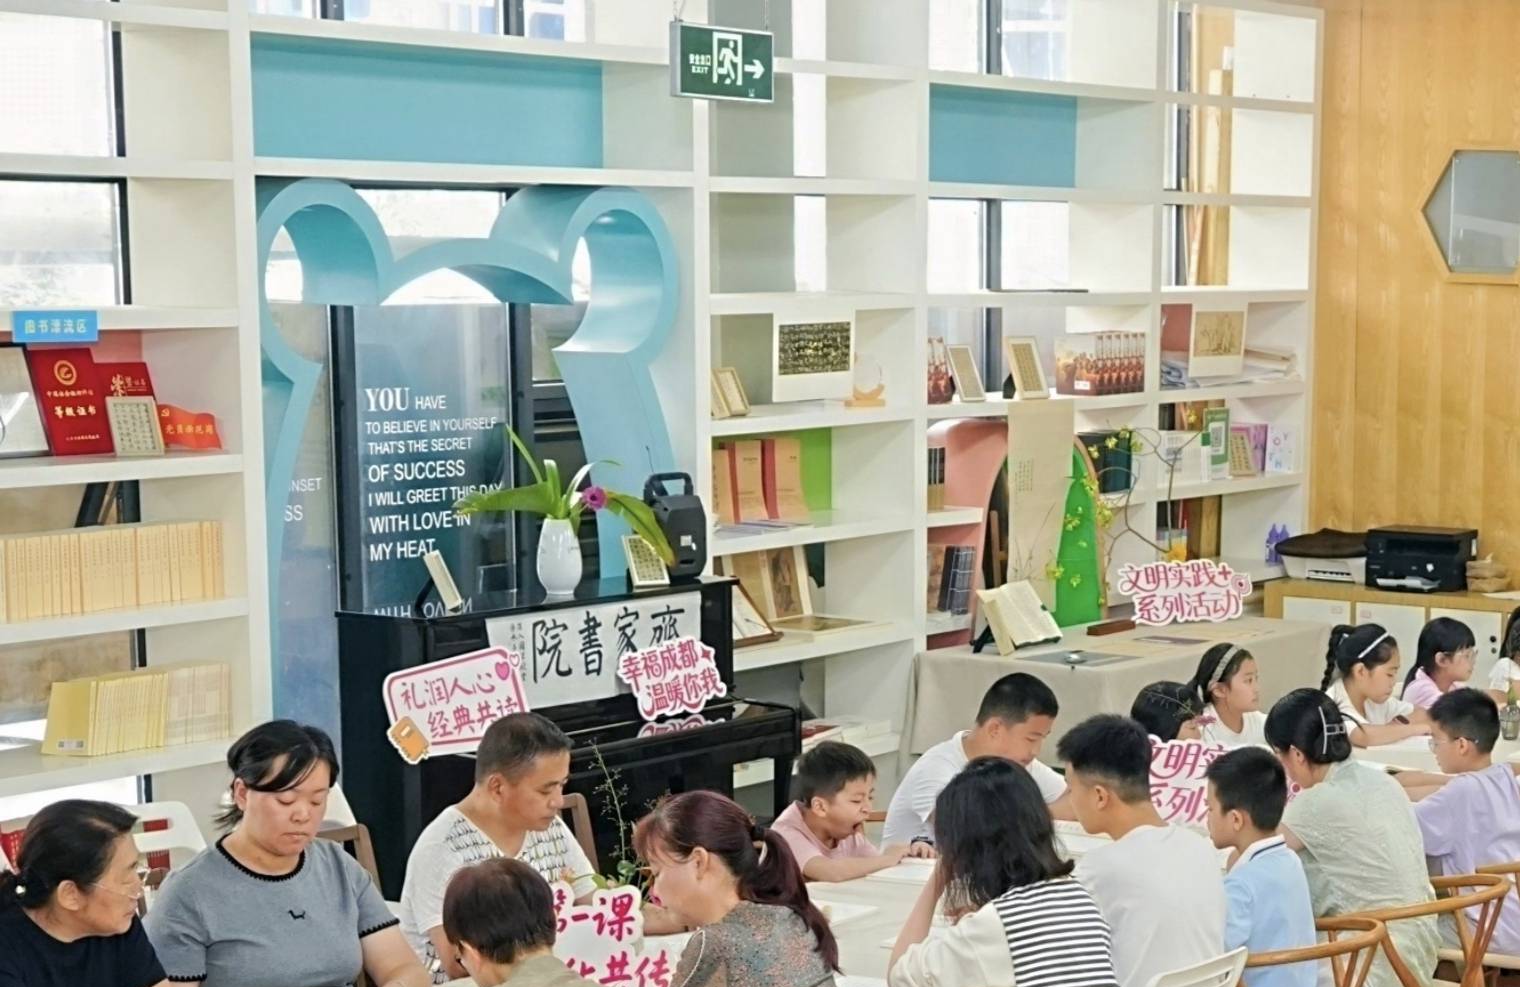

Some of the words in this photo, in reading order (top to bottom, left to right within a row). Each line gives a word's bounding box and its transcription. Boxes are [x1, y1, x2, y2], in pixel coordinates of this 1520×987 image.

[691, 66, 709, 74] EXIT
[365, 387, 410, 412] YOU
[415, 395, 447, 410] HAVE
[366, 421, 380, 434] TO
[383, 419, 427, 434] BELIEVE
[430, 419, 440, 432] IN
[442, 416, 497, 431] YOURSELF
[407, 439, 429, 452] THE
[431, 437, 472, 451] SECRET
[368, 464, 389, 482] OF
[393, 459, 466, 481] SUCCESS
[368, 493, 373, 507] I
[375, 491, 404, 506] WILL
[406, 487, 447, 504] GREET
[369, 513, 409, 534] WITH
[413, 510, 452, 530] LOVE
[369, 542, 393, 561] MY
[1135, 589, 1240, 624] 系列活动
[622, 640, 698, 692] 幸福成都
[401, 672, 495, 710] 礼润人心
[642, 667, 723, 716] 温暖你我
